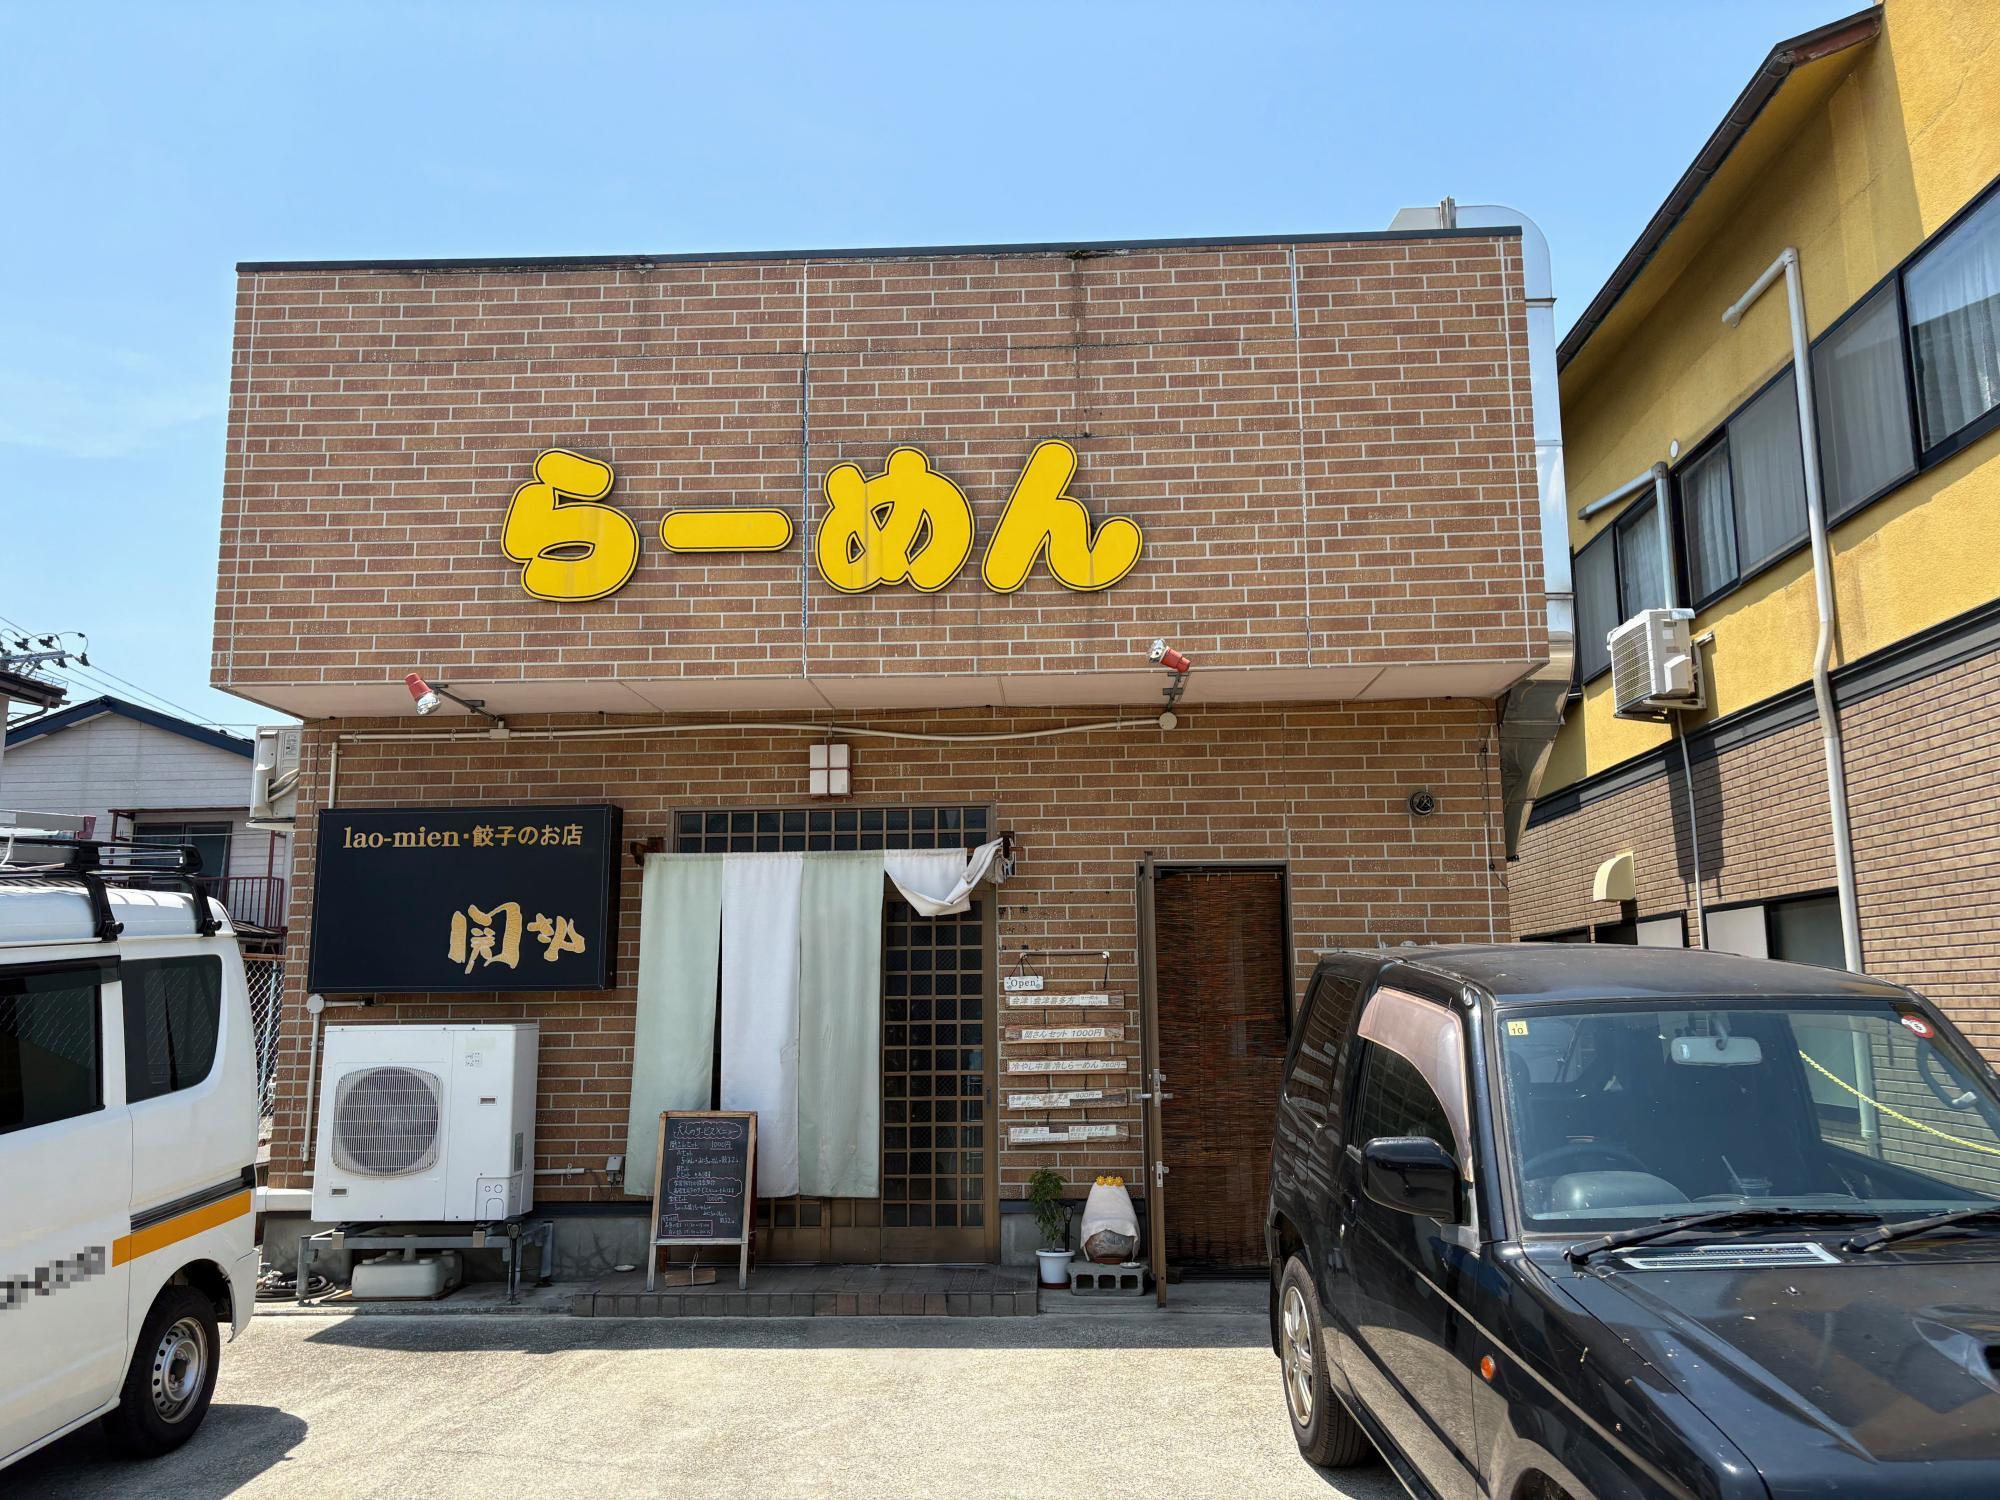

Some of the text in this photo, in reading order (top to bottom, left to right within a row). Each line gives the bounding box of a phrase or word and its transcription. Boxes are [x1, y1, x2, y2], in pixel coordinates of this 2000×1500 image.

[501, 440, 1144, 601] らーめん
[1010, 978, 1036, 989] Open
